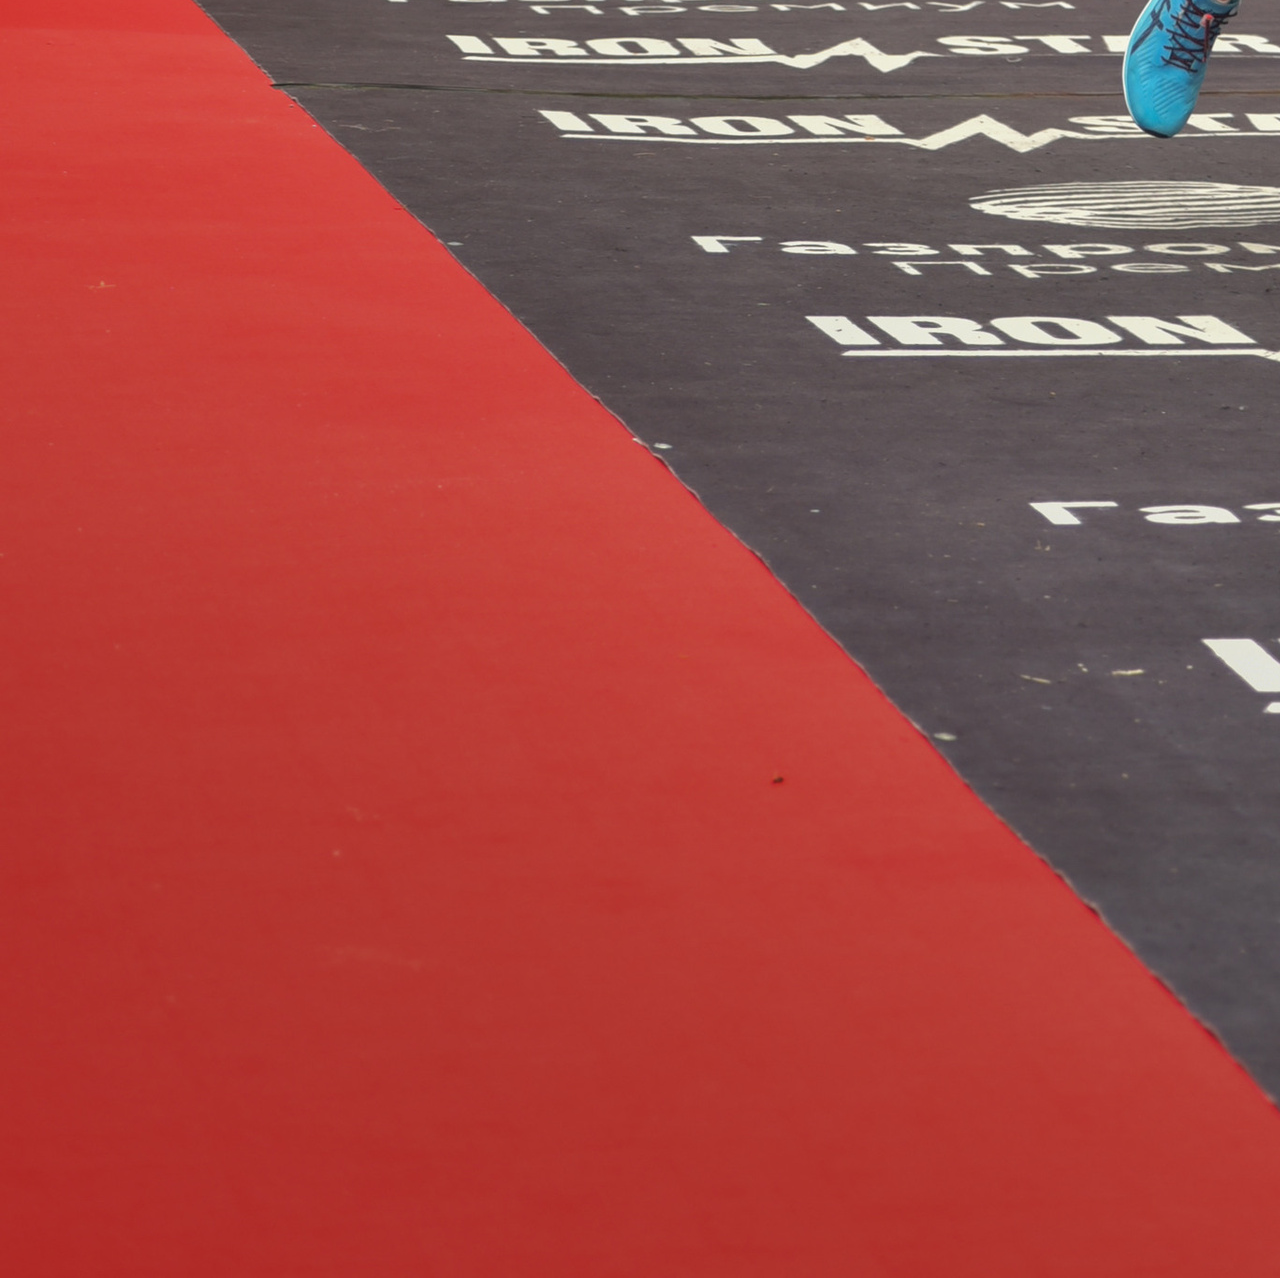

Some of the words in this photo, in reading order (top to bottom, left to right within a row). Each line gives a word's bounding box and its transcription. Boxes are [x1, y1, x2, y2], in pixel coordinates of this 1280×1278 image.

[529, 0, 1076, 16] Премиум
[444, 35, 779, 56] IRON
[537, 110, 906, 136] IRON
[805, 314, 1259, 346] IRON
